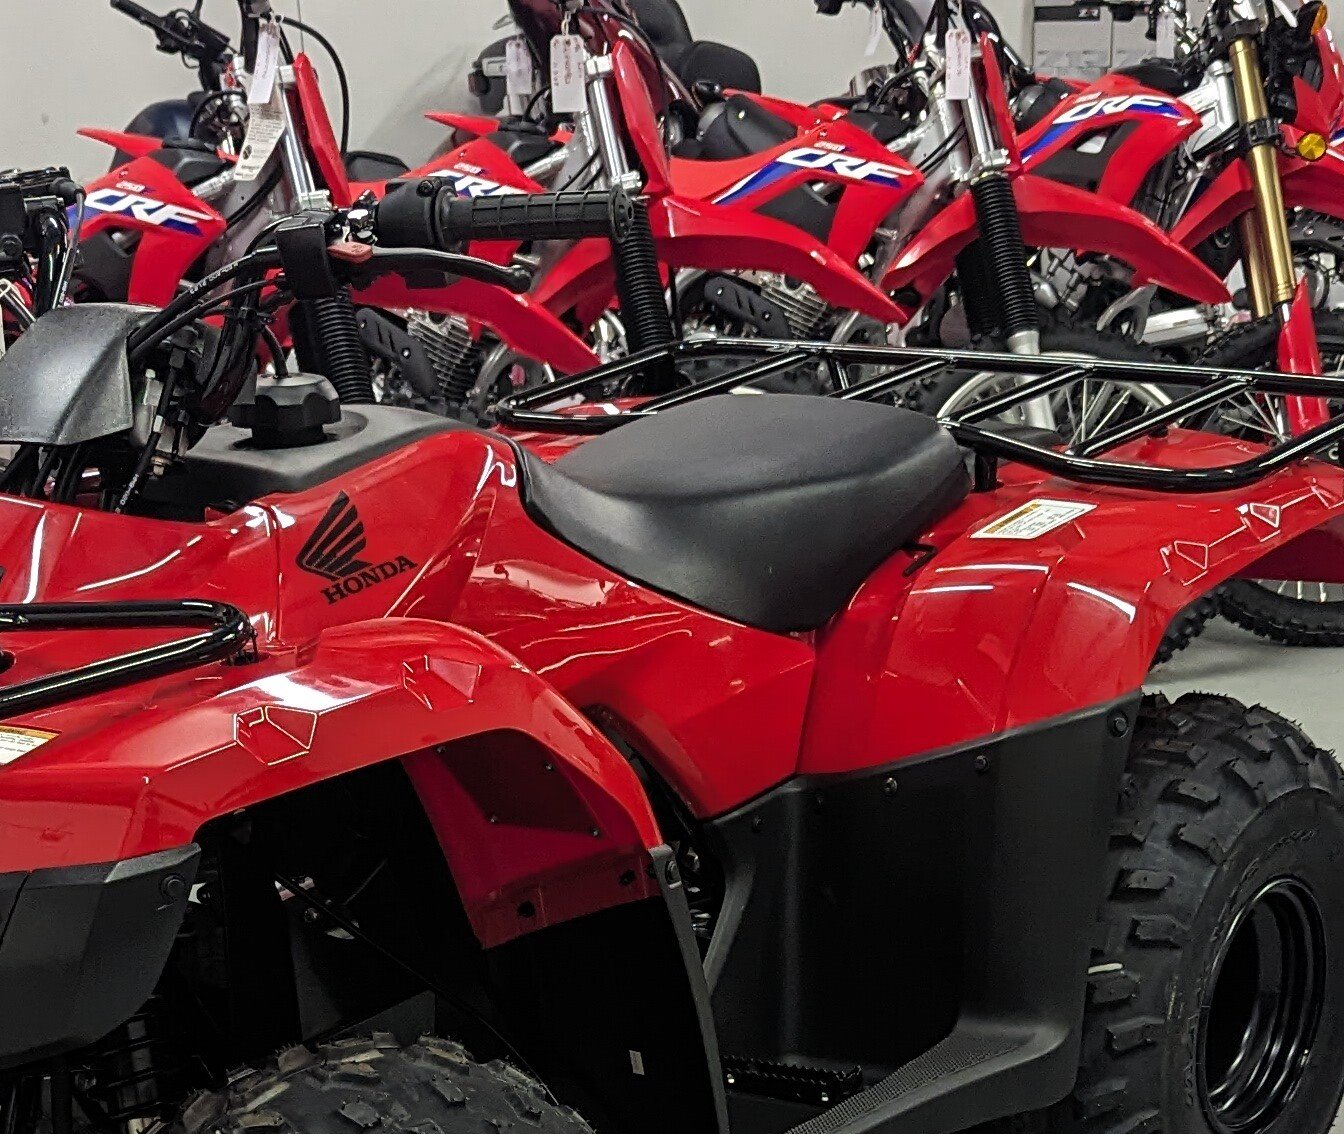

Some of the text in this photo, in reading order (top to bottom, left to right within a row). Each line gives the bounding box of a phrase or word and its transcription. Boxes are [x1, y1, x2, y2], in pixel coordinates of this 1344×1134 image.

[1052, 95, 1178, 125] CRF
[775, 147, 914, 180] CRF
[85, 188, 214, 225] CRF
[320, 555, 419, 605] HONDA
